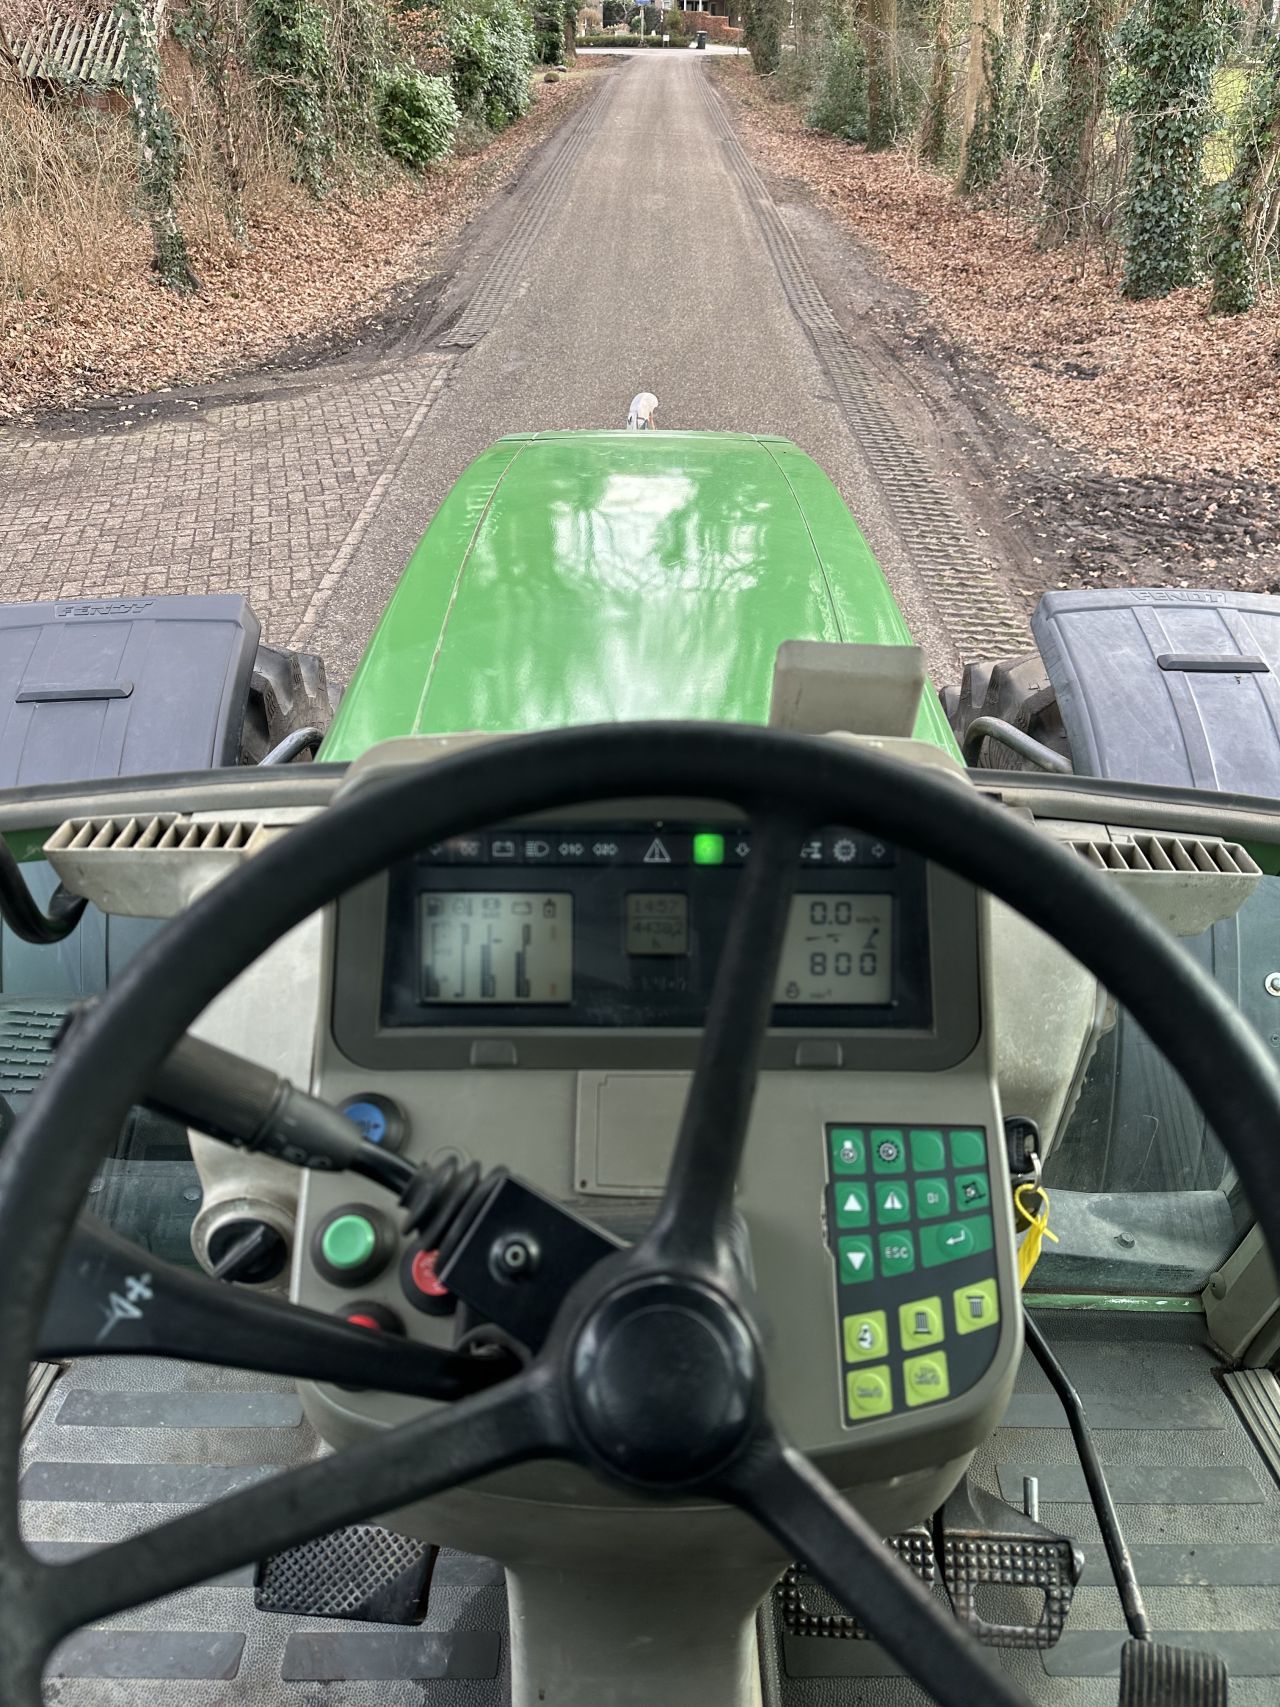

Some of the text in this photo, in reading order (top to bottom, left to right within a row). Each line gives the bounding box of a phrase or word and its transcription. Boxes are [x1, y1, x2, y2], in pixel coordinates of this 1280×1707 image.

[1131, 591, 1222, 602] FENDT
[58, 602, 154, 616] FENDT
[810, 901, 852, 925] 0.0
[809, 952, 877, 977] 800
[886, 1247, 909, 1258] ESC
